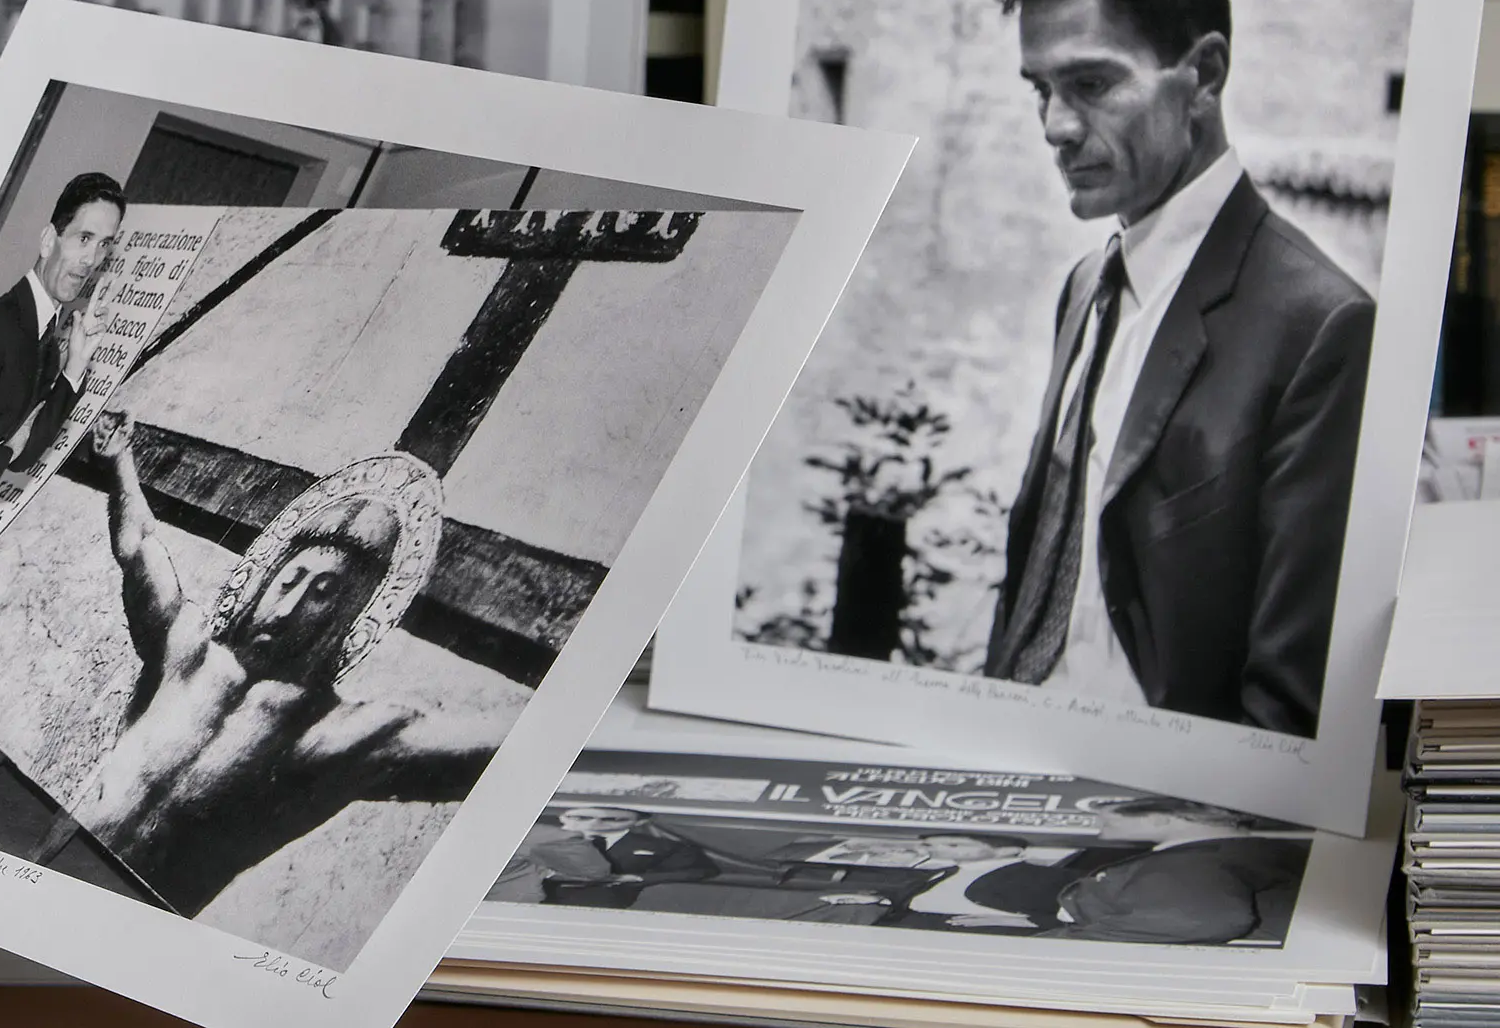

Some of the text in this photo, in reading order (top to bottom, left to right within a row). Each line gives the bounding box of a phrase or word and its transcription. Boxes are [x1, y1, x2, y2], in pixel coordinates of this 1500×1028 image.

[124, 228, 203, 252] generazione
[131, 255, 166, 282] figlio
[168, 259, 190, 281] di
[112, 283, 165, 310] Abramo.
[106, 313, 148, 345] Isacco,
[14, 866, 44, 885] 1963
[233, 951, 337, 1000] Elio Ciol
